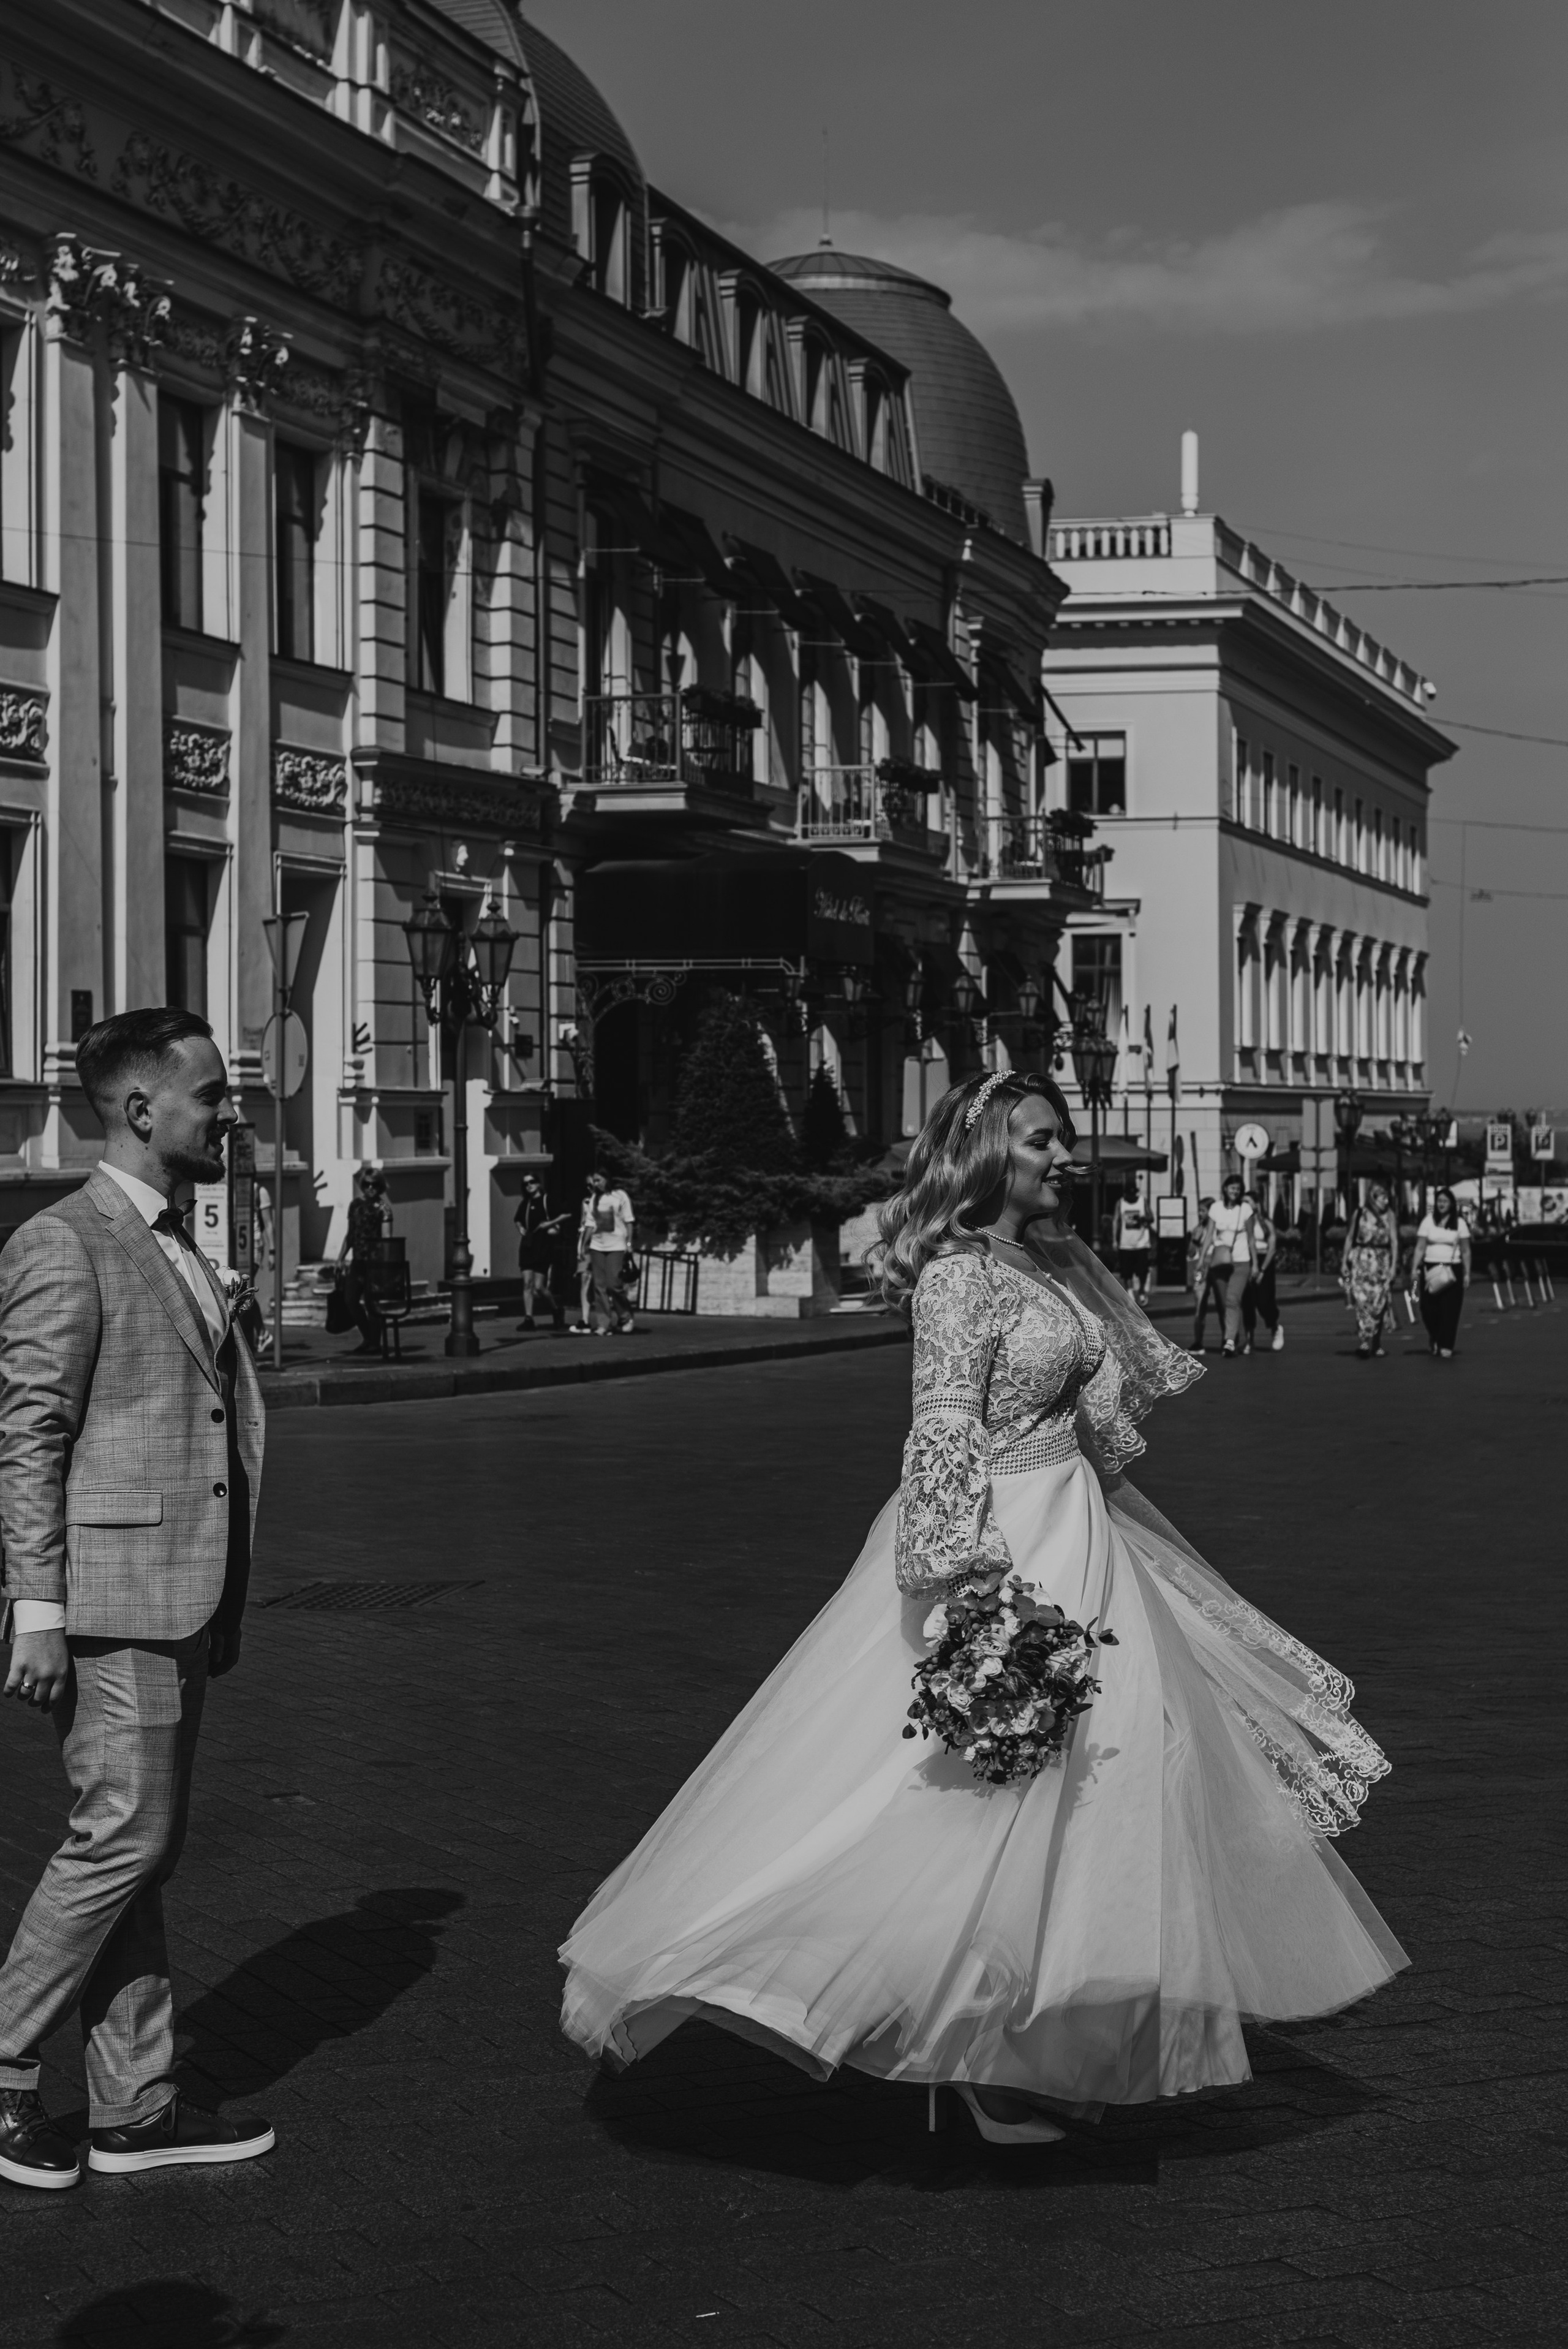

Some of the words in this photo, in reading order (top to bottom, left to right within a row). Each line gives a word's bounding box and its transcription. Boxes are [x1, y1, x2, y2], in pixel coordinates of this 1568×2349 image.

[1494, 1135, 1506, 1151] P
[205, 1205, 219, 1228] 5
[239, 1225, 247, 1250] 5
